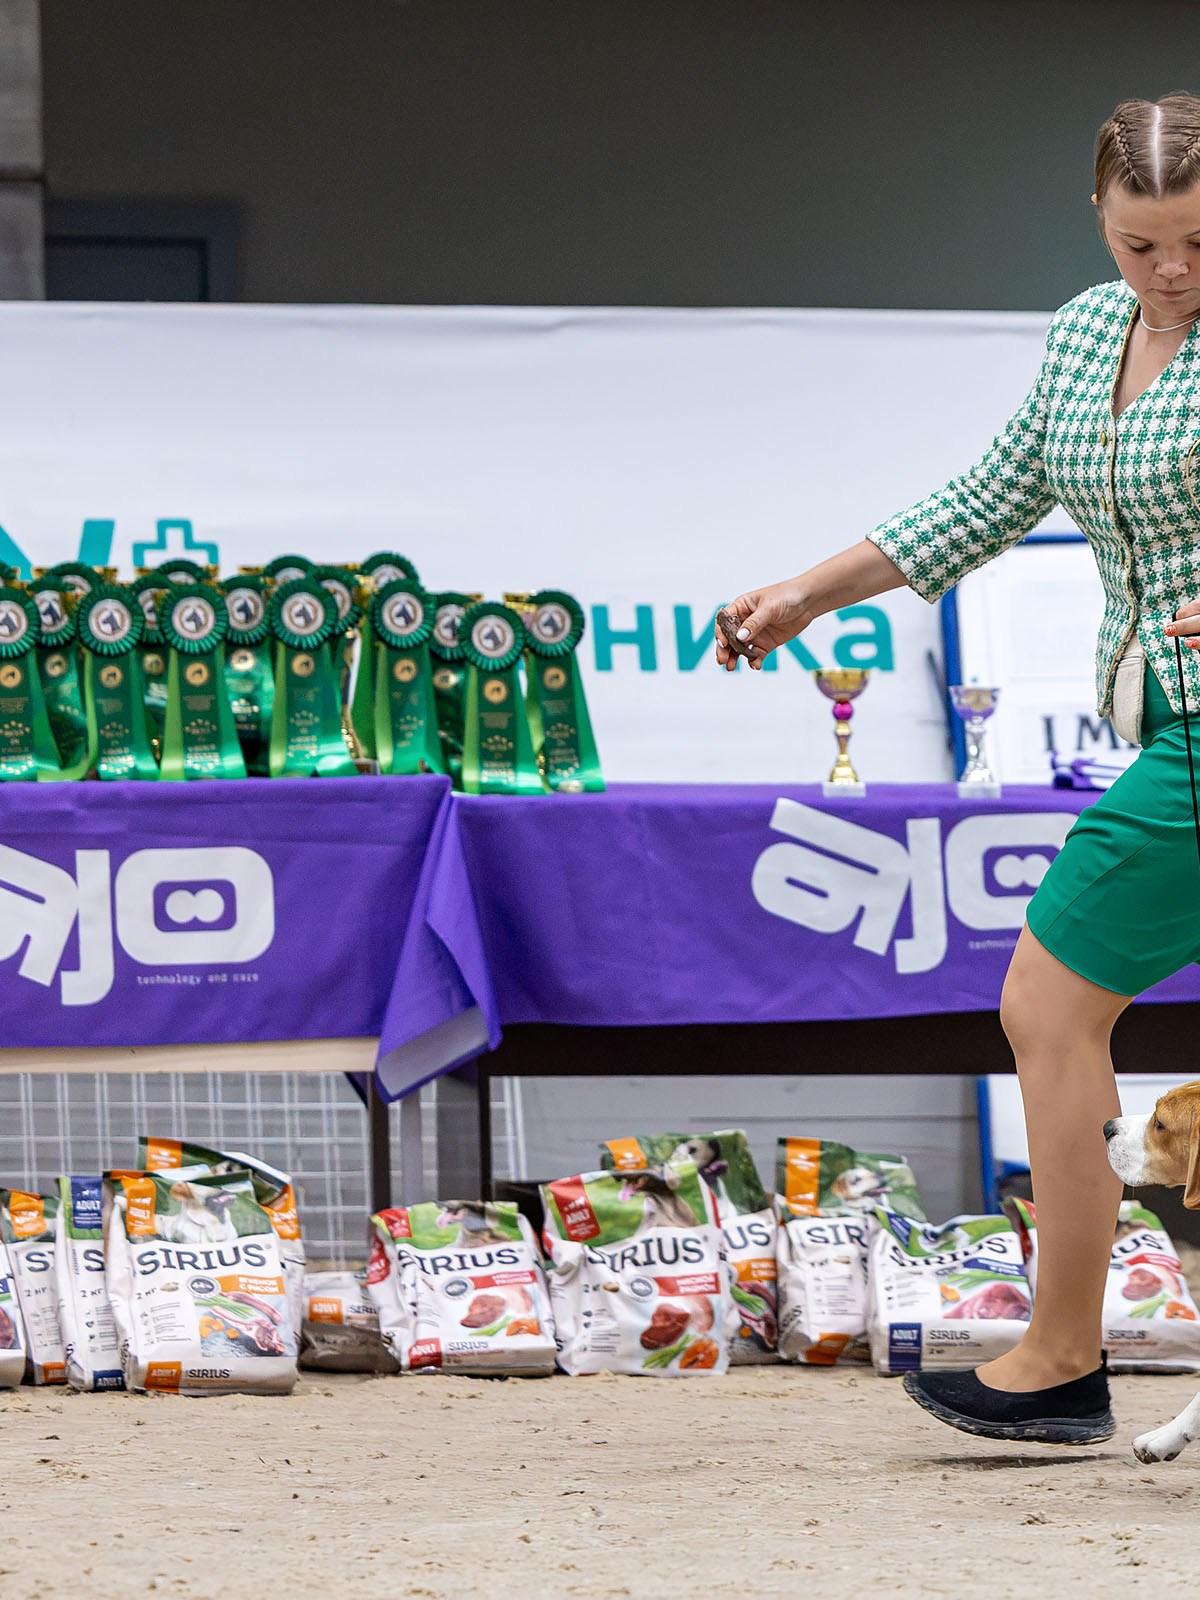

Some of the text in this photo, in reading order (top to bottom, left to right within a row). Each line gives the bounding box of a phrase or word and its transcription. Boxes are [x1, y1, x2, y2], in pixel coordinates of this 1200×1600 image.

[137, 1242, 267, 1275] SIRIUS
[928, 1330, 971, 1340] SIRIUS
[448, 1340, 489, 1351] SIRIUS
[188, 1368, 231, 1379] SIRIUS
